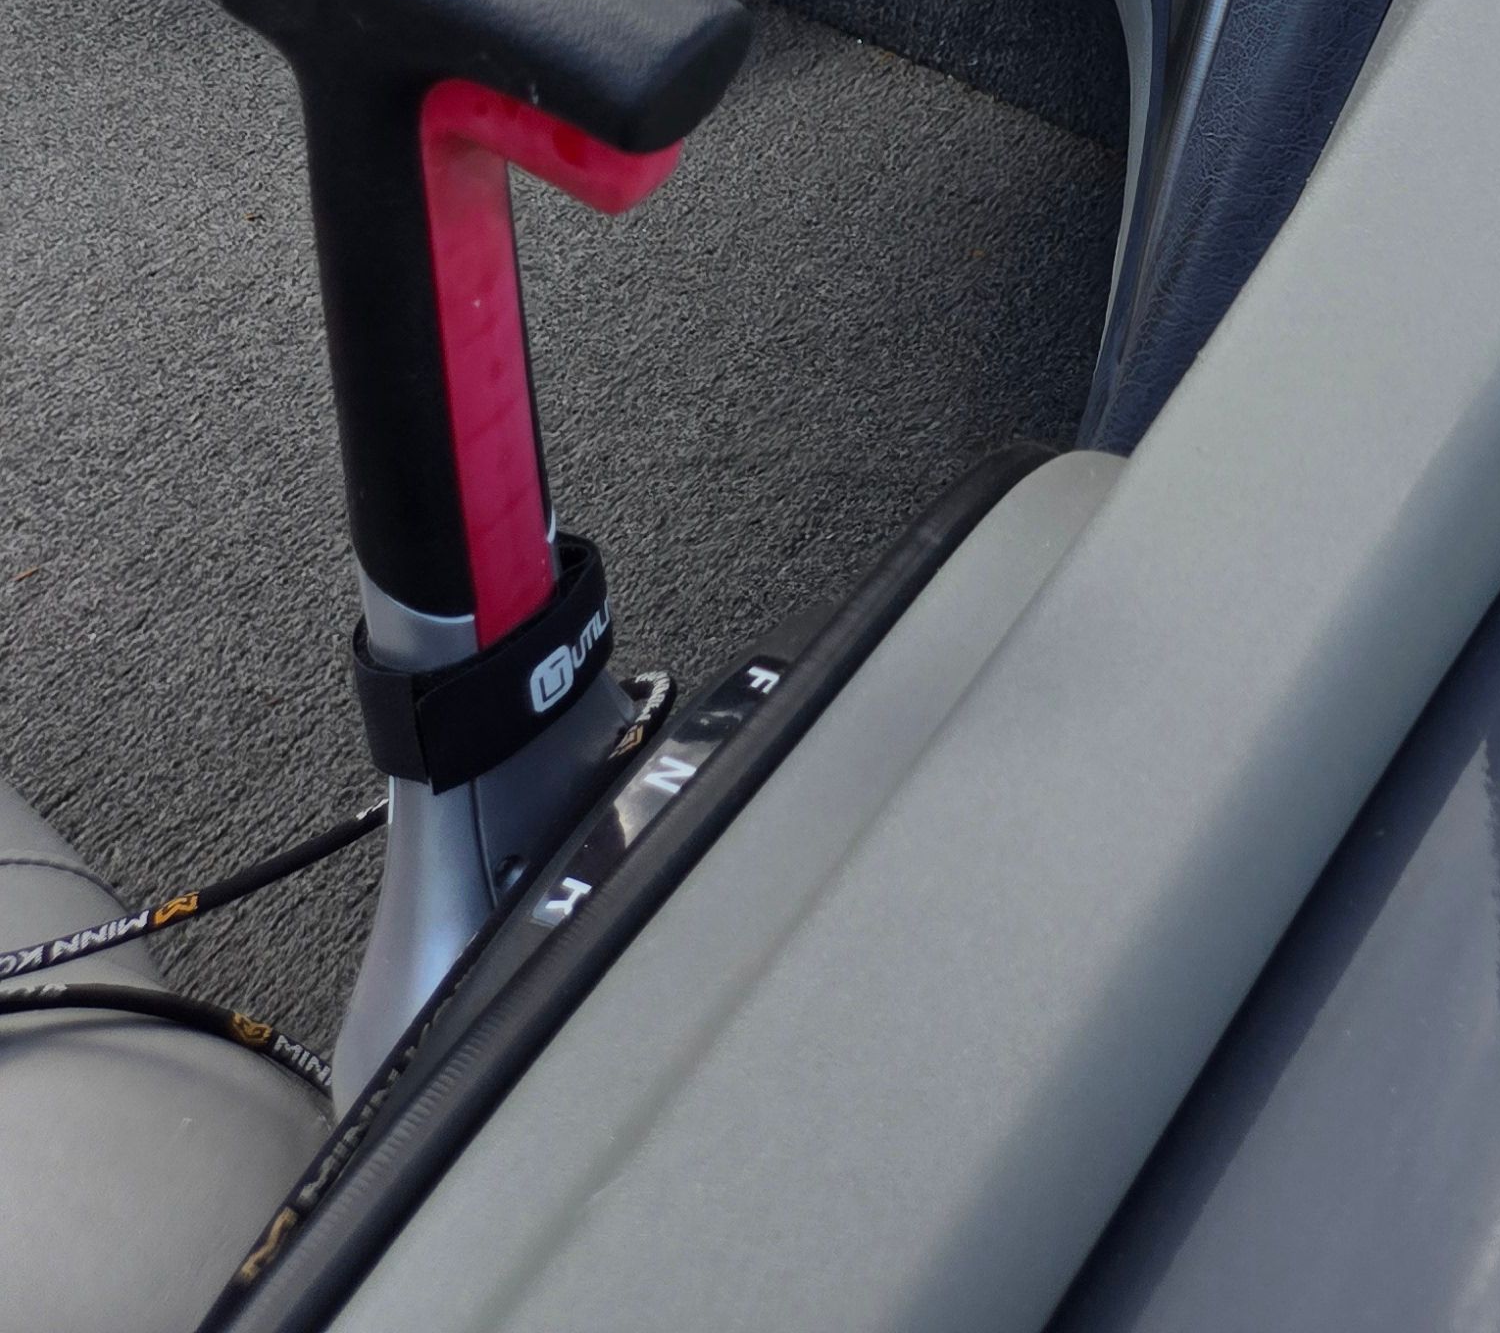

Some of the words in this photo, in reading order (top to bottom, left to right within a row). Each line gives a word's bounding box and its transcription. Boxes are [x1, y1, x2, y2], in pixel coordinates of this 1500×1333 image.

[747, 665, 780, 695] F
[644, 756, 698, 795] N
[52, 909, 149, 963] MINN
[273, 1035, 331, 1086] MIN
